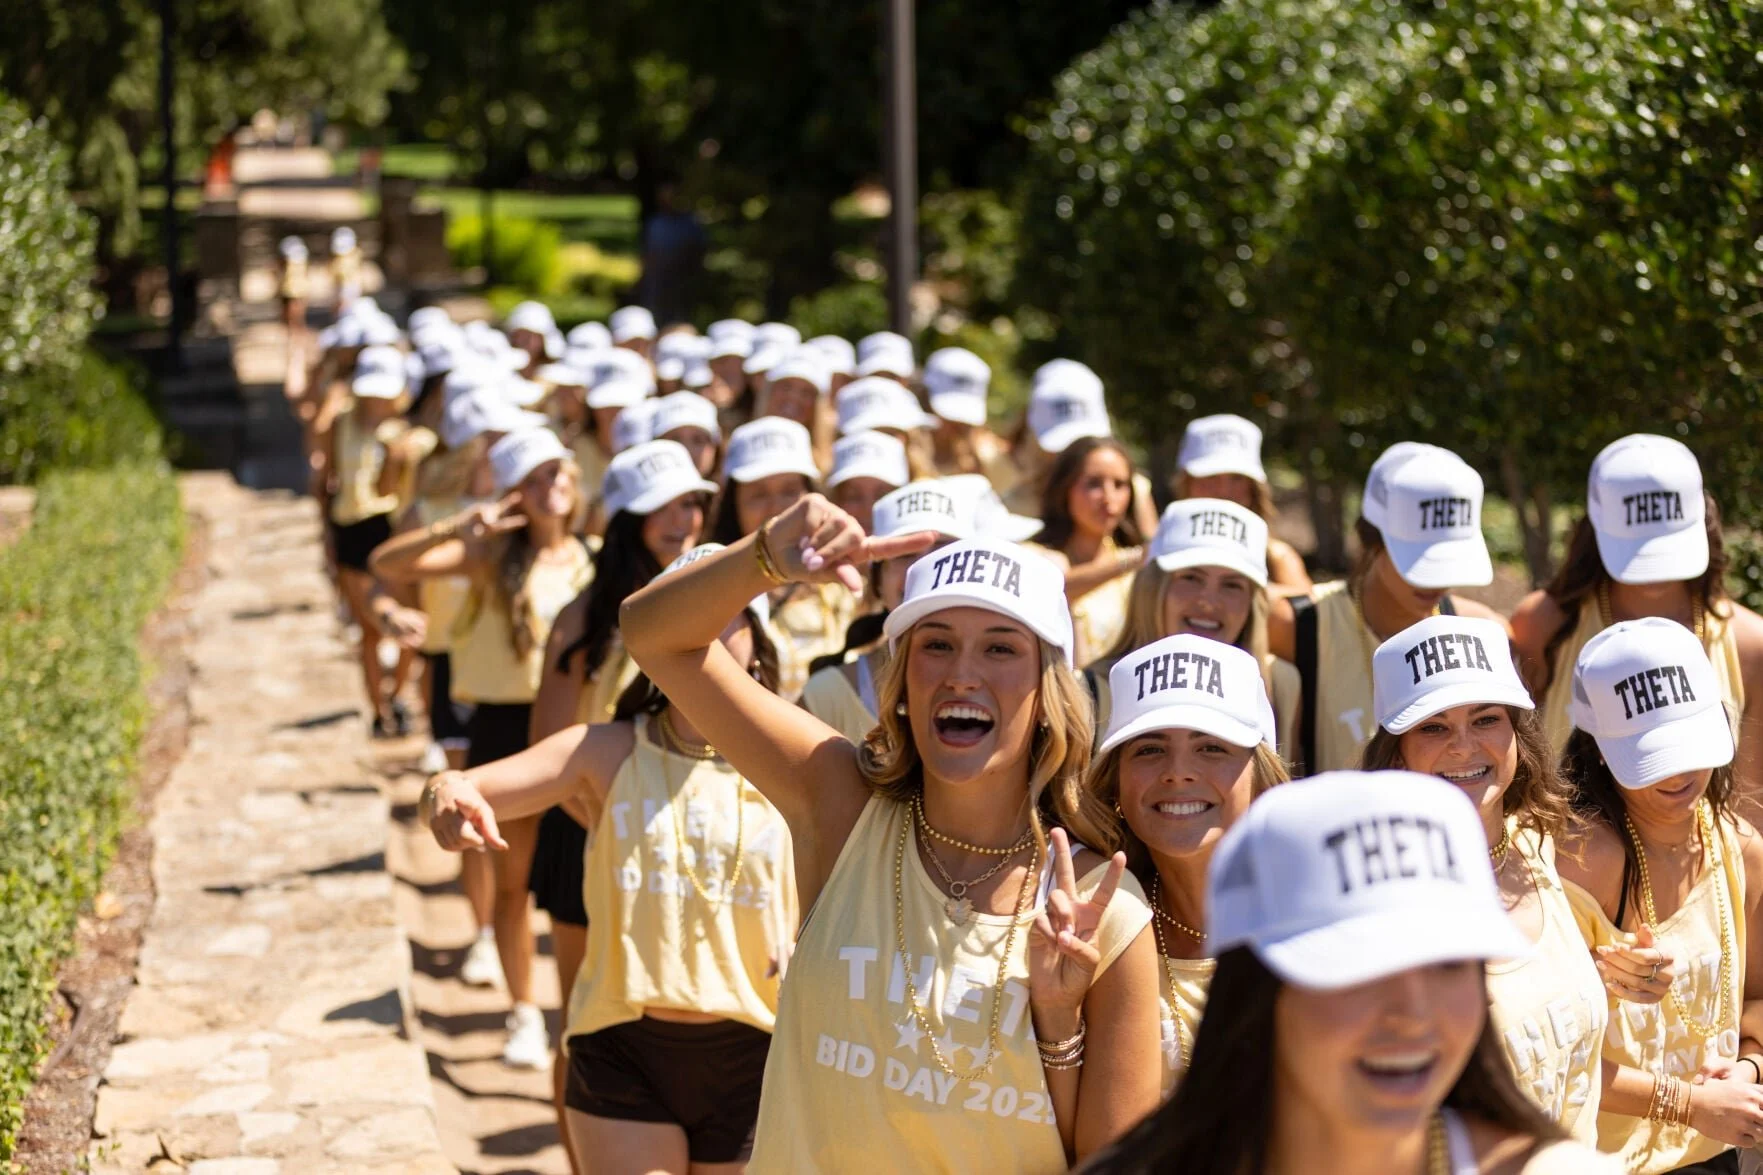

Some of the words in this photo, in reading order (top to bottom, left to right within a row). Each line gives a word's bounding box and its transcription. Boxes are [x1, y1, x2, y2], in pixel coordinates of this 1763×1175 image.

[897, 491, 956, 519] THETA
[1189, 511, 1248, 546] THETA
[1621, 491, 1684, 527] THETA
[931, 550, 1022, 598] THETA
[1134, 652, 1225, 701] THETA
[1404, 633, 1493, 685] THETA
[1614, 665, 1697, 720] THETA
[1323, 816, 1465, 894] THETA
[838, 946, 1036, 1041] THET
[815, 1033, 876, 1079] BID
[883, 1056, 960, 1105] DAY
